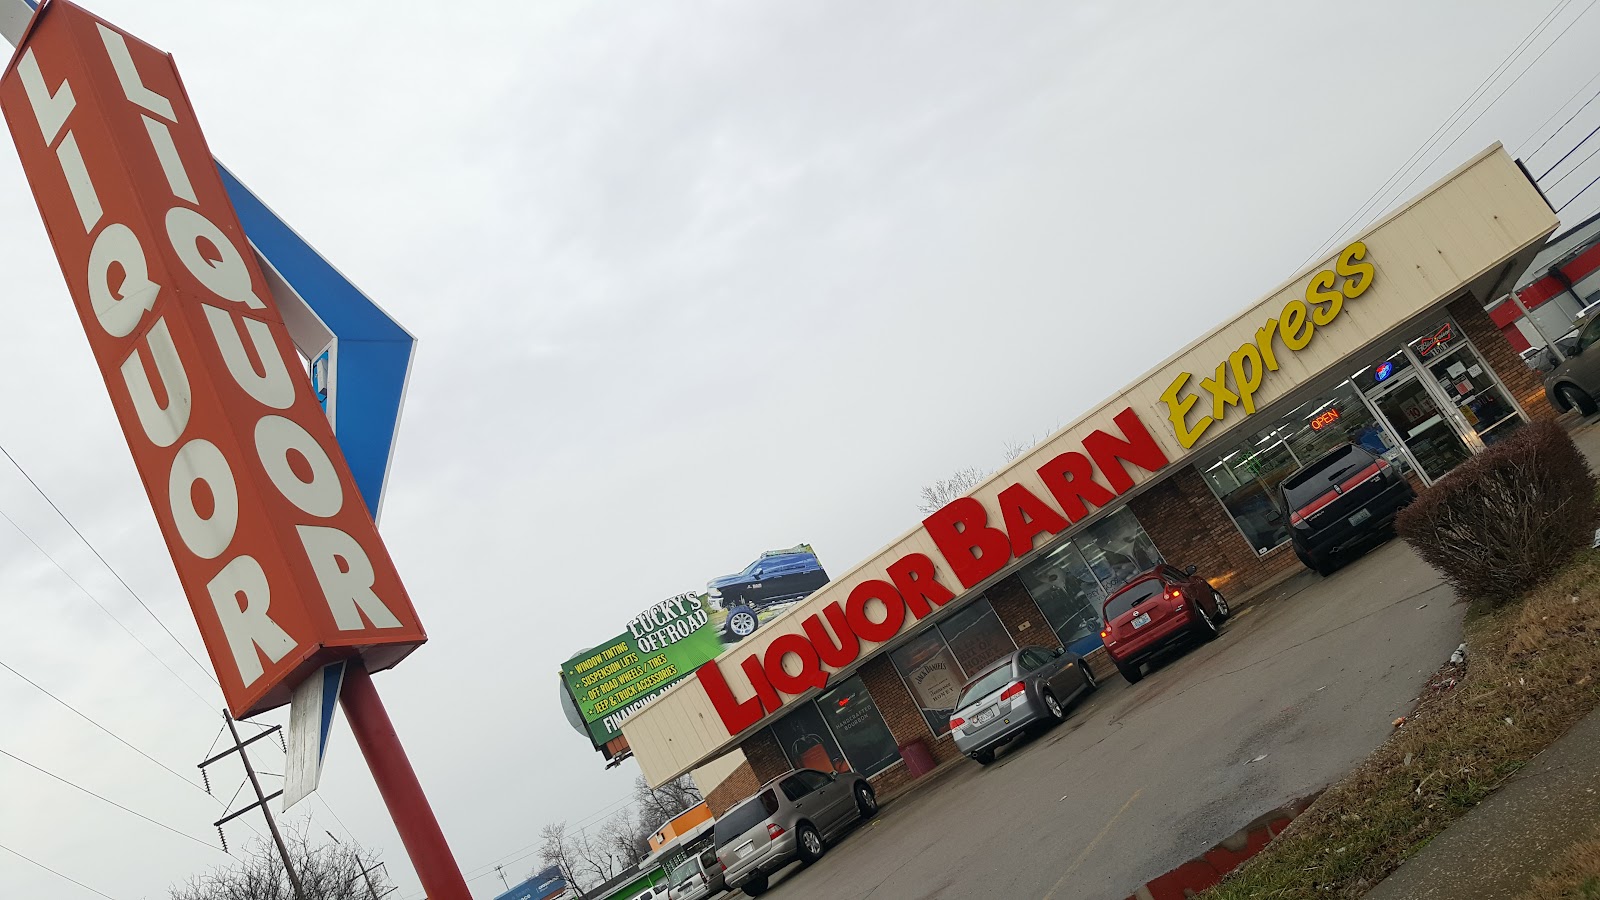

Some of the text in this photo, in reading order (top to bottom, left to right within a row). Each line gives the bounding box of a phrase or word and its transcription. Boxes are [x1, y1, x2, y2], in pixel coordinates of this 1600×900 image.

[95, 22, 403, 631] LIQUOR
[17, 46, 298, 689] LIQUOR
[1311, 409, 1338, 430] OPEN
[696, 241, 1375, 736] LIQUOR BARN Express
[627, 591, 702, 639] LUCKY'S
[637, 609, 709, 653] OFFROAD
[574, 642, 628, 674] WINDOW TINTING
[581, 652, 639, 687] SUSPENSION LIFTS
[587, 687, 602, 700] OFF
[600, 679, 619, 694] ROAD
[617, 666, 644, 685] WHEELS
[648, 654, 667, 669] TIRES
[915, 670, 928, 685] JACK
[594, 700, 610, 714] JEEP
[609, 695, 617, 706] &
[615, 686, 637, 702] TRUCK
[636, 665, 677, 692] ACCESSORIES
[835, 704, 872, 729] HANDCRAFTED
[844, 714, 869, 730] BOURBON
